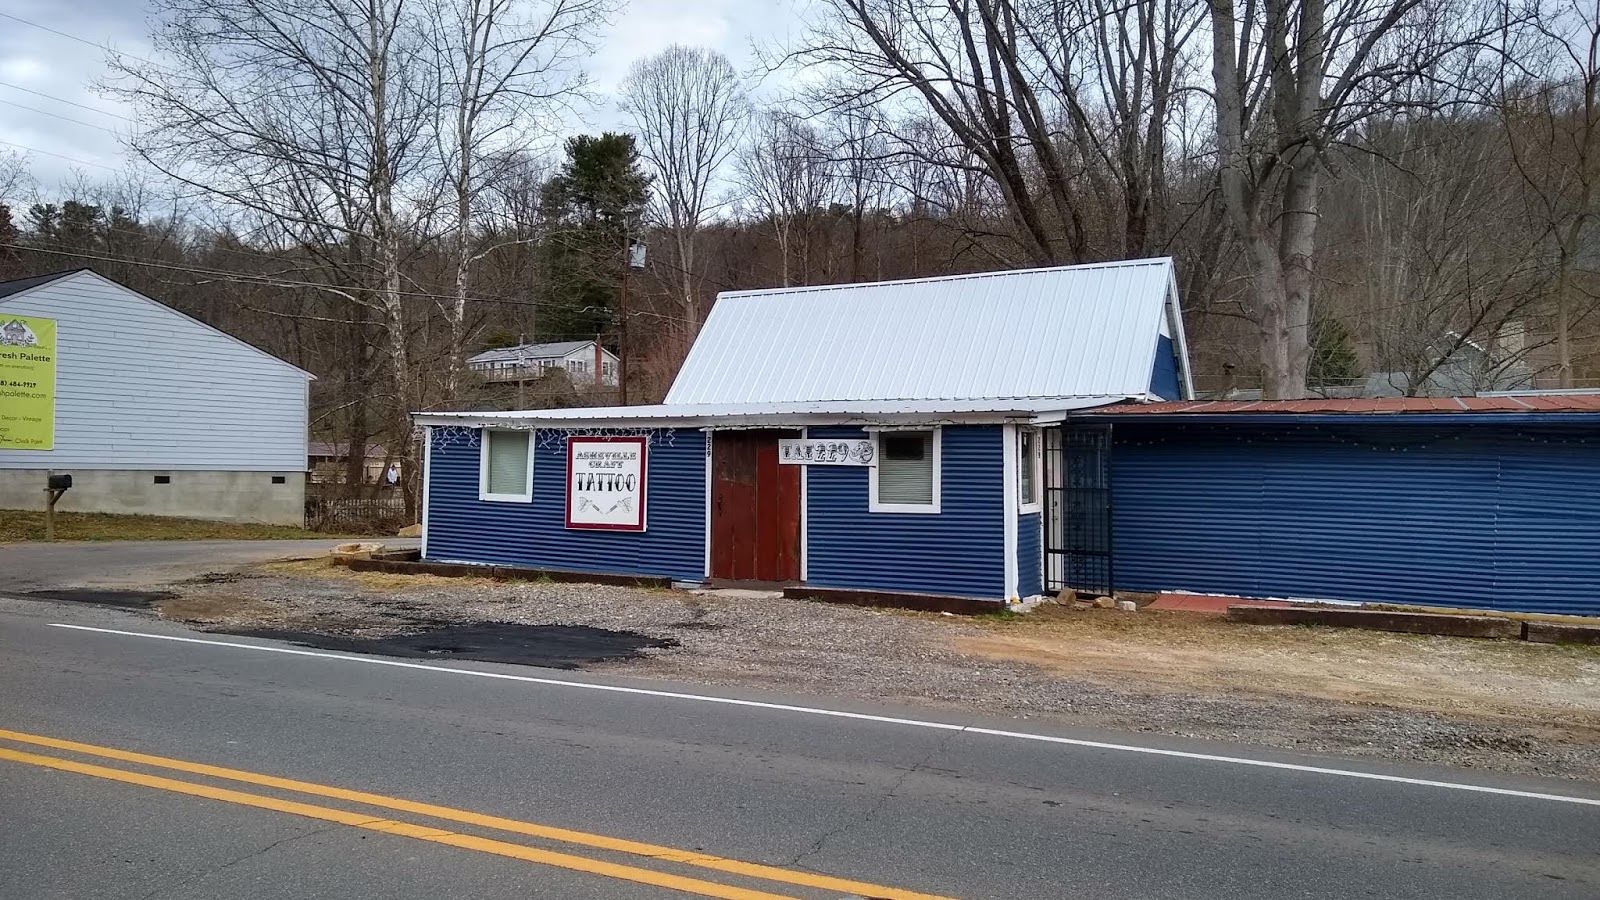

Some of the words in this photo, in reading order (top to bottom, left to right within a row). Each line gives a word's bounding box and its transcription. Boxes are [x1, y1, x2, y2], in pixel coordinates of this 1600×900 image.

[19, 352, 51, 363] Palette
[576, 452, 637, 460] ASHEVILLE
[588, 460, 624, 469] CRAFT
[576, 472, 636, 492] TATTOO
